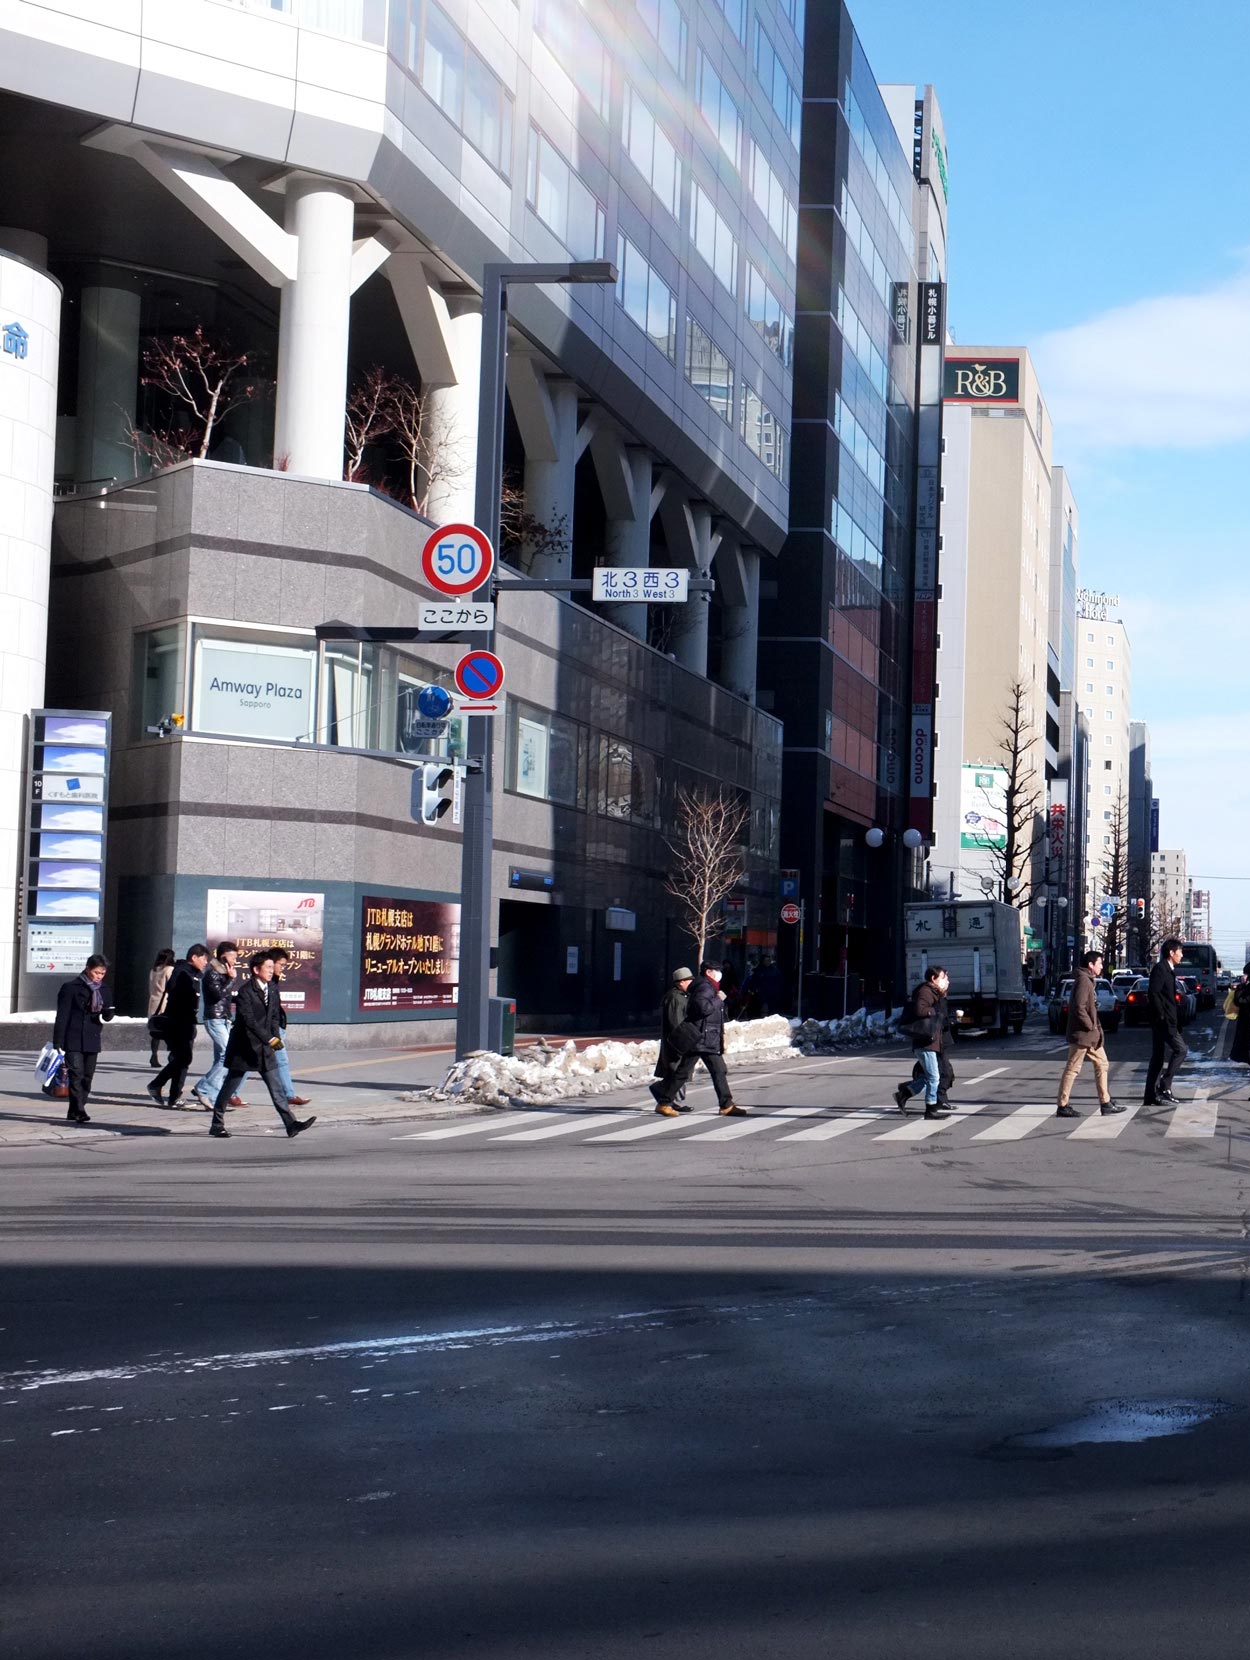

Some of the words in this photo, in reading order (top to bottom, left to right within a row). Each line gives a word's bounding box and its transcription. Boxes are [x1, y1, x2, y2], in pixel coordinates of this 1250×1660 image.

[954, 369, 1007, 397] R&B
[437, 543, 476, 575] 50
[605, 589, 631, 599] North
[633, 590, 639, 598] 3
[643, 590, 667, 599] West
[668, 590, 675, 598] 3
[423, 609, 488, 624] ここから
[210, 677, 262, 699] Amway
[265, 682, 303, 699] Plaza
[239, 698, 271, 708] Sapporo
[915, 728, 927, 784] docomo
[783, 880, 795, 895] P
[297, 898, 316, 909] JTB
[366, 908, 414, 928] JTB札幌支店は
